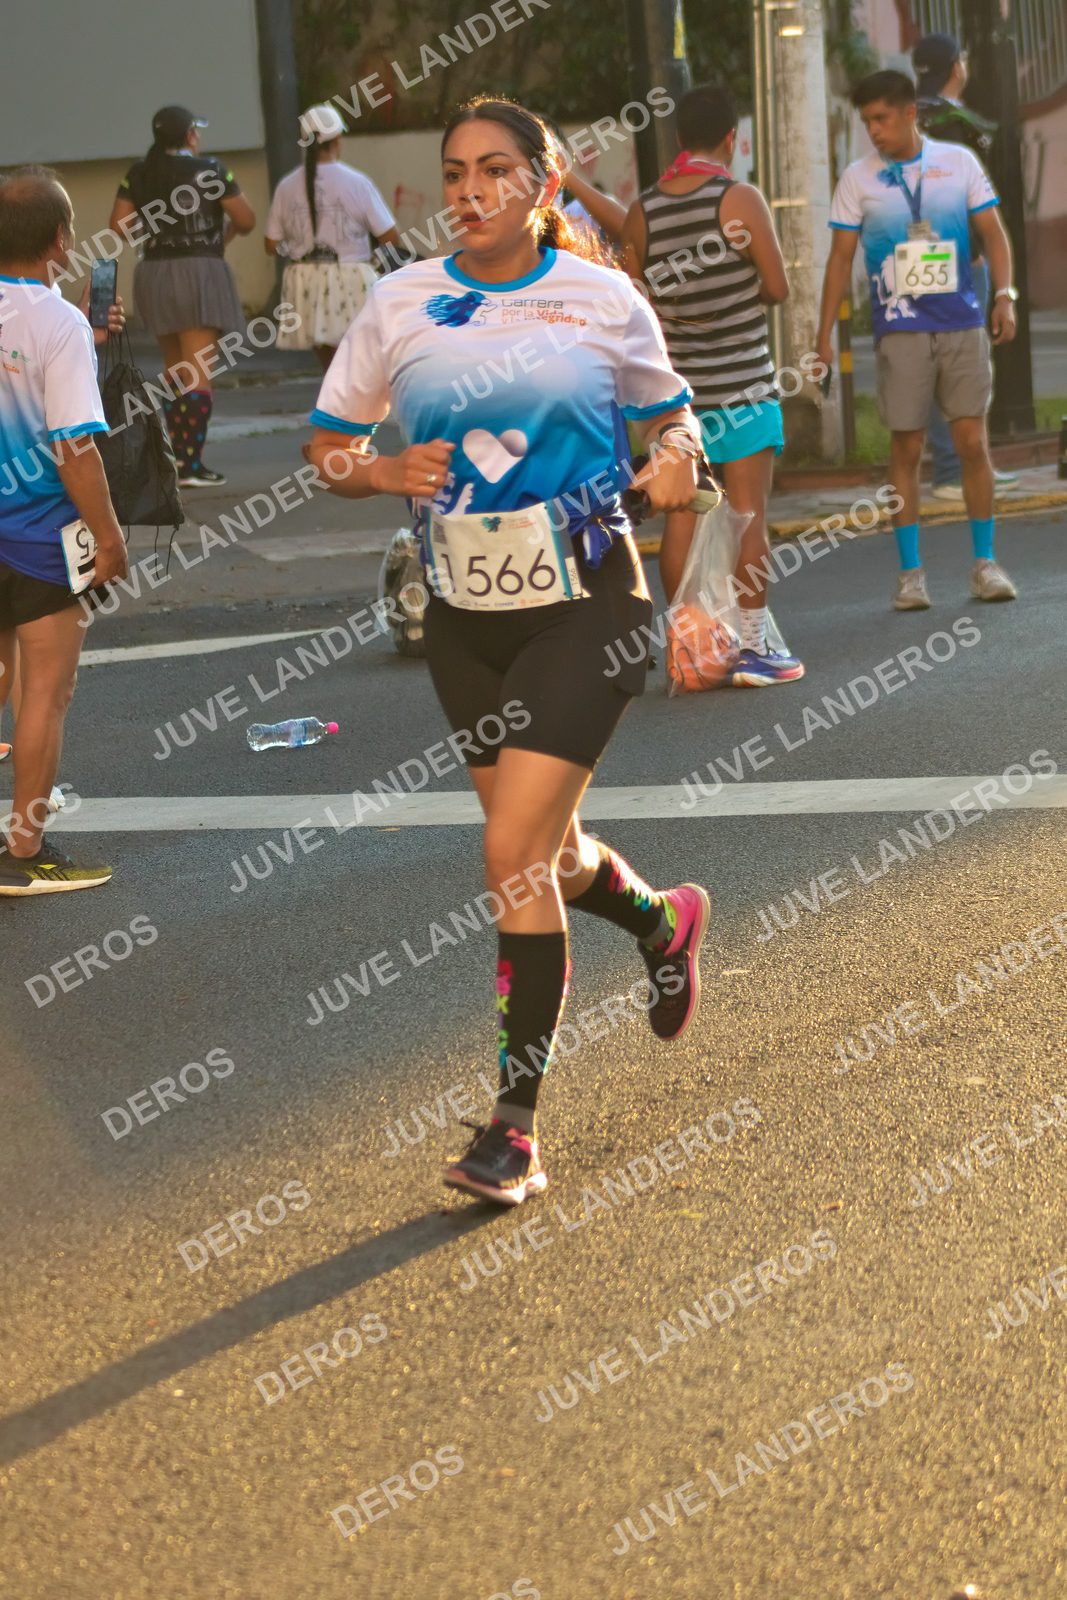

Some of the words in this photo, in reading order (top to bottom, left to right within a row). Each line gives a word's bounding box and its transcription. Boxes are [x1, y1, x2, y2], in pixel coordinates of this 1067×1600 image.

[905, 264, 949, 287] 655
[501, 298, 564, 309] Carrera
[441, 548, 557, 598] 1566
